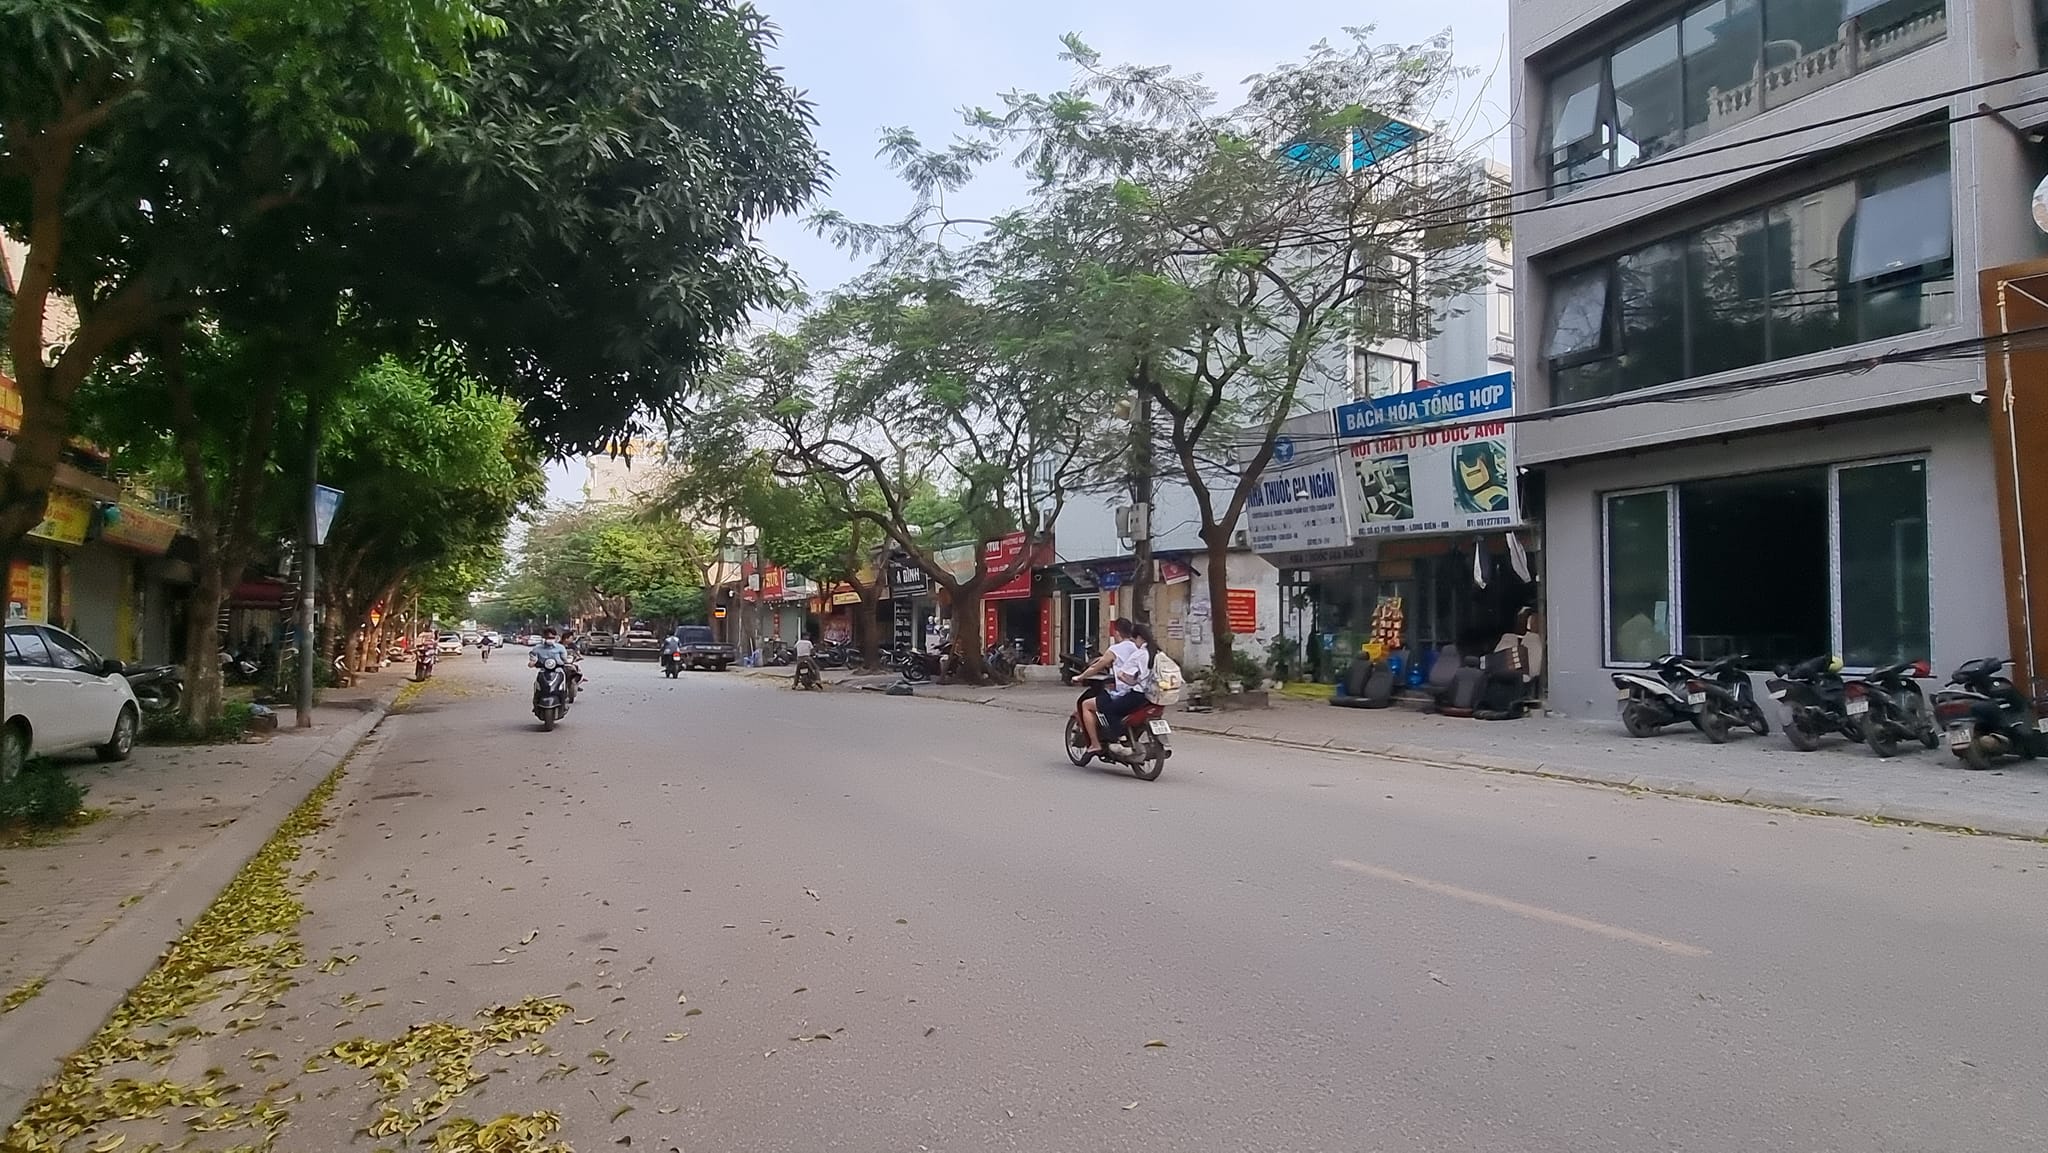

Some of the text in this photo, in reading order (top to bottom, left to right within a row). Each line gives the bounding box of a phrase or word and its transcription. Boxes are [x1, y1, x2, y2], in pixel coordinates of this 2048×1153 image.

[1346, 384, 1505, 431] BÁCH HÓA TỔNG HỢP
